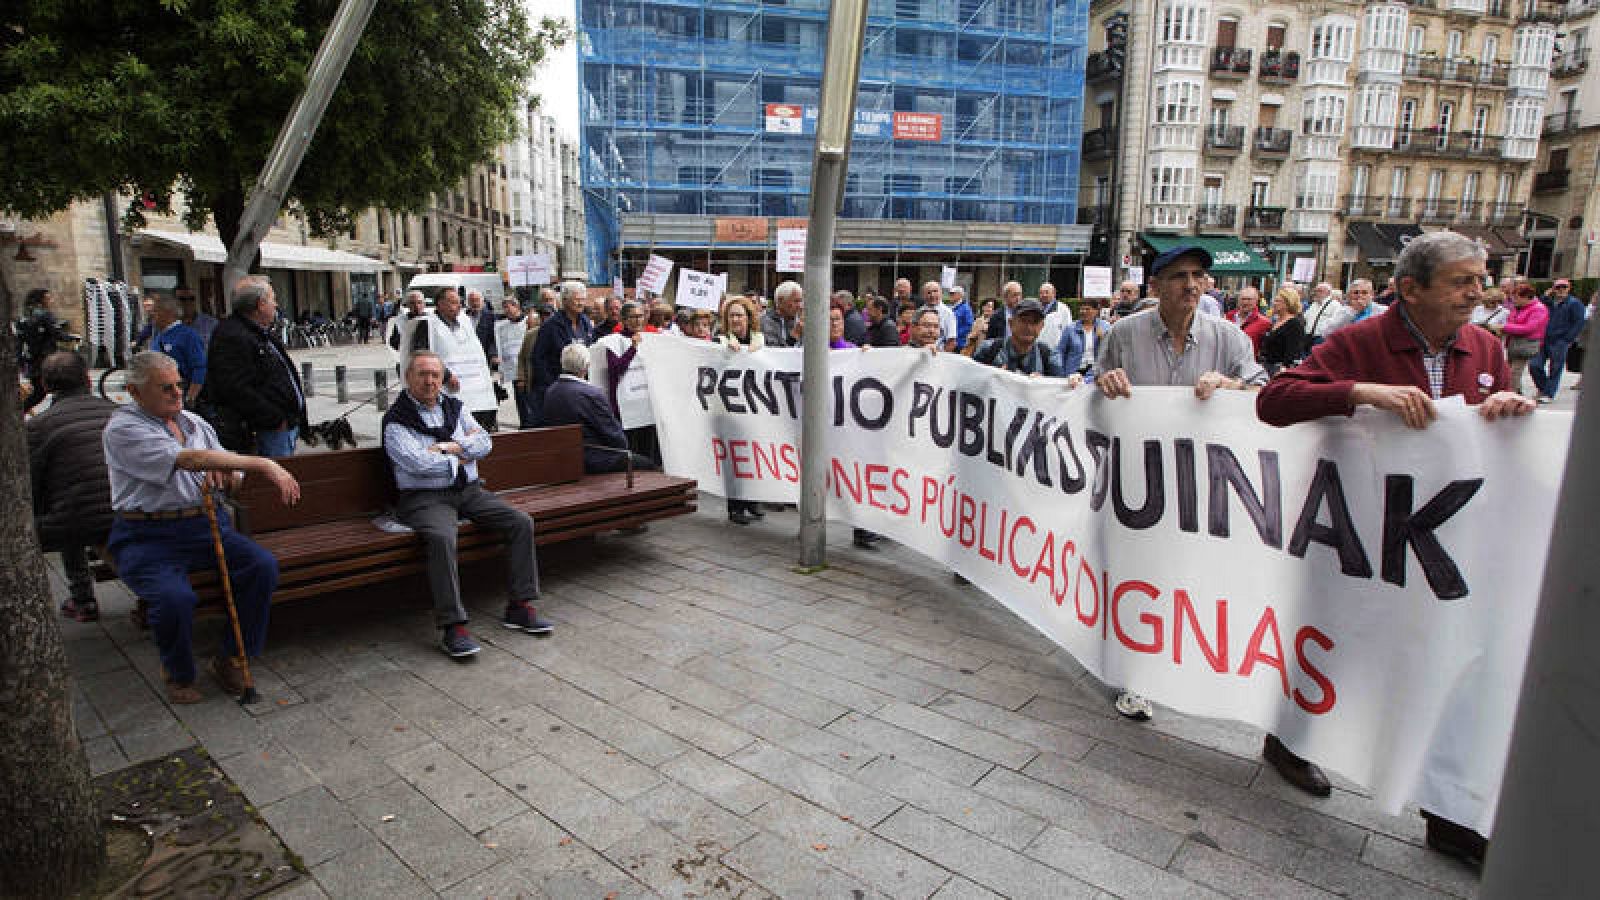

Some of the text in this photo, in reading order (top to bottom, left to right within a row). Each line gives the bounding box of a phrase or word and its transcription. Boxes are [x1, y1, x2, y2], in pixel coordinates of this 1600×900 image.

[697, 368, 893, 430] PENTIO
[908, 382, 1087, 494] PUBLIKO
[712, 437, 1336, 714] PENSNES PÚBLICAS DIGNAS
